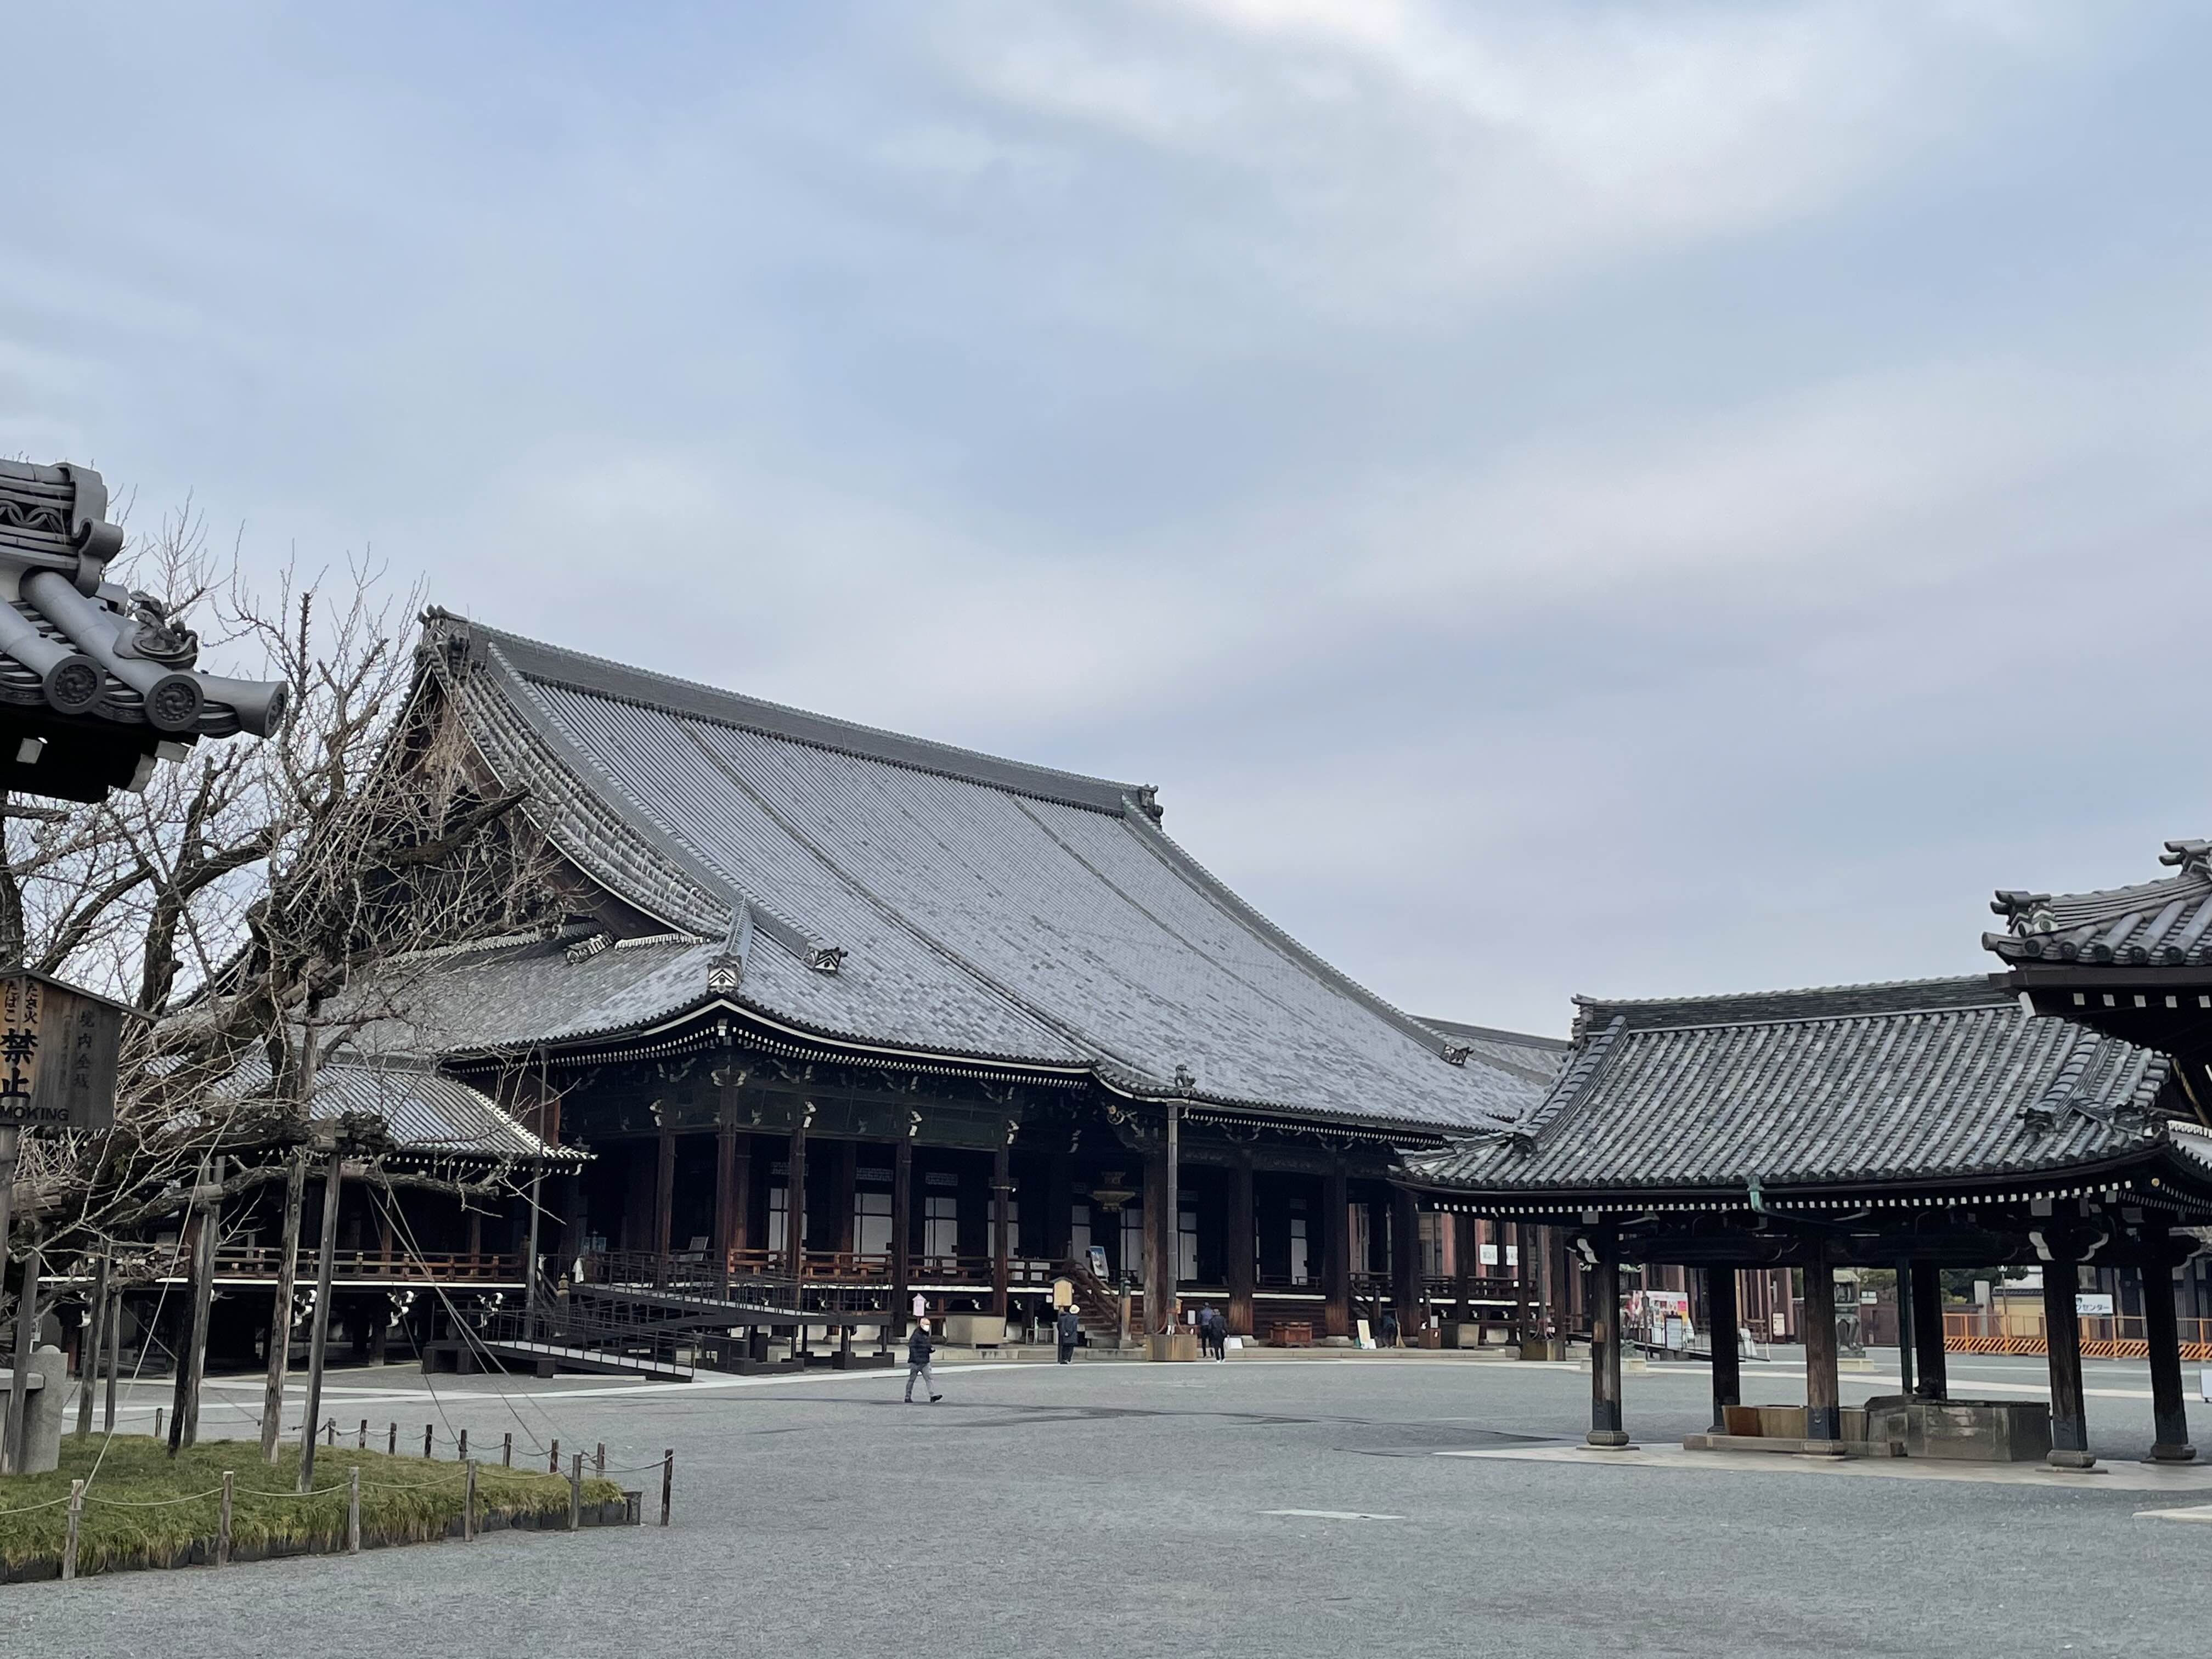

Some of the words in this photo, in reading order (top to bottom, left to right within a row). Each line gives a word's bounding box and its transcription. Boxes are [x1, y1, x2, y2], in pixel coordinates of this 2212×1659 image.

[22, 983, 38, 1024] たき火
[0, 1028, 38, 1099] 禁止
